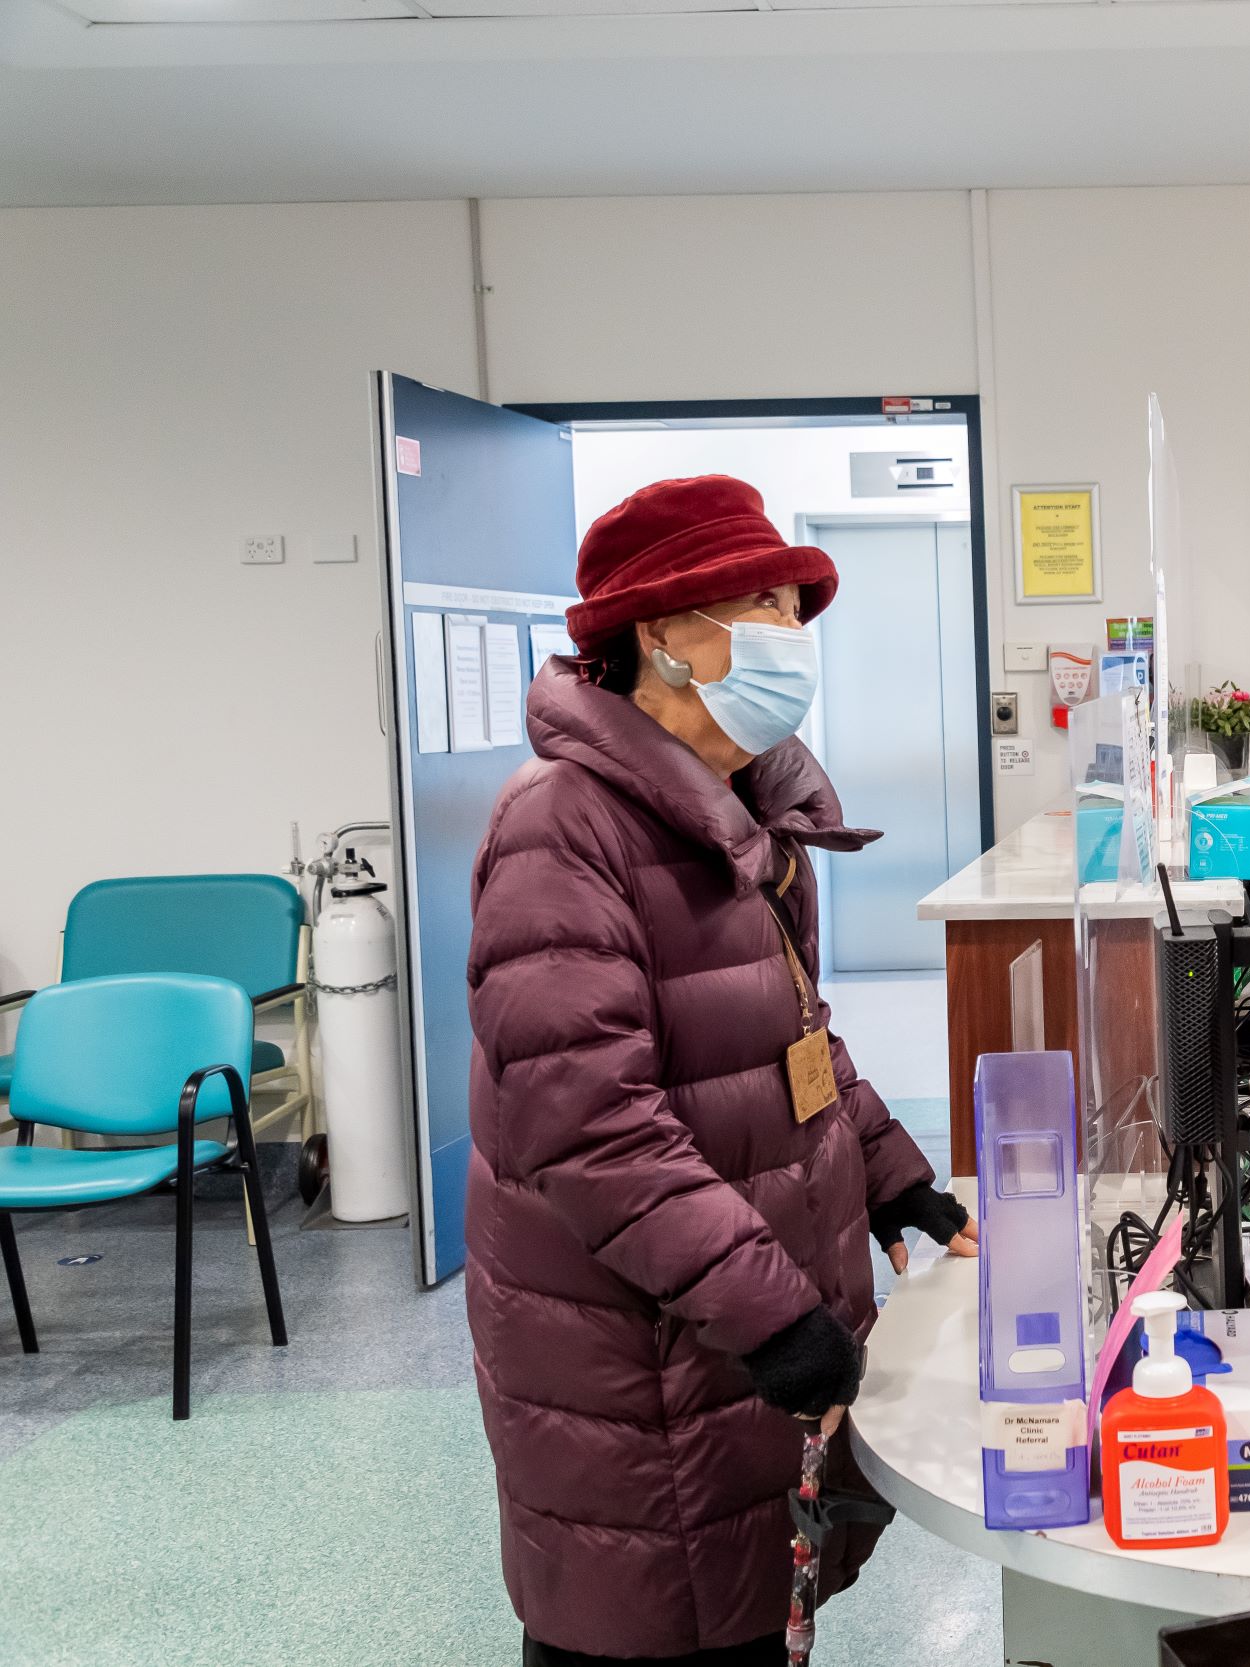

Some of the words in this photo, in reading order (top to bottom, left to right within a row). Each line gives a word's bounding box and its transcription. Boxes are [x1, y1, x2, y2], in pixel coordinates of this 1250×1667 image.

[1004, 1417, 1014, 1425] Dr
[1016, 1436, 1048, 1444] Referral
[1123, 1443, 1182, 1460] Cutan
[1131, 1476, 1172, 1489] Alcohol
[1175, 1475, 1206, 1487] Foam
